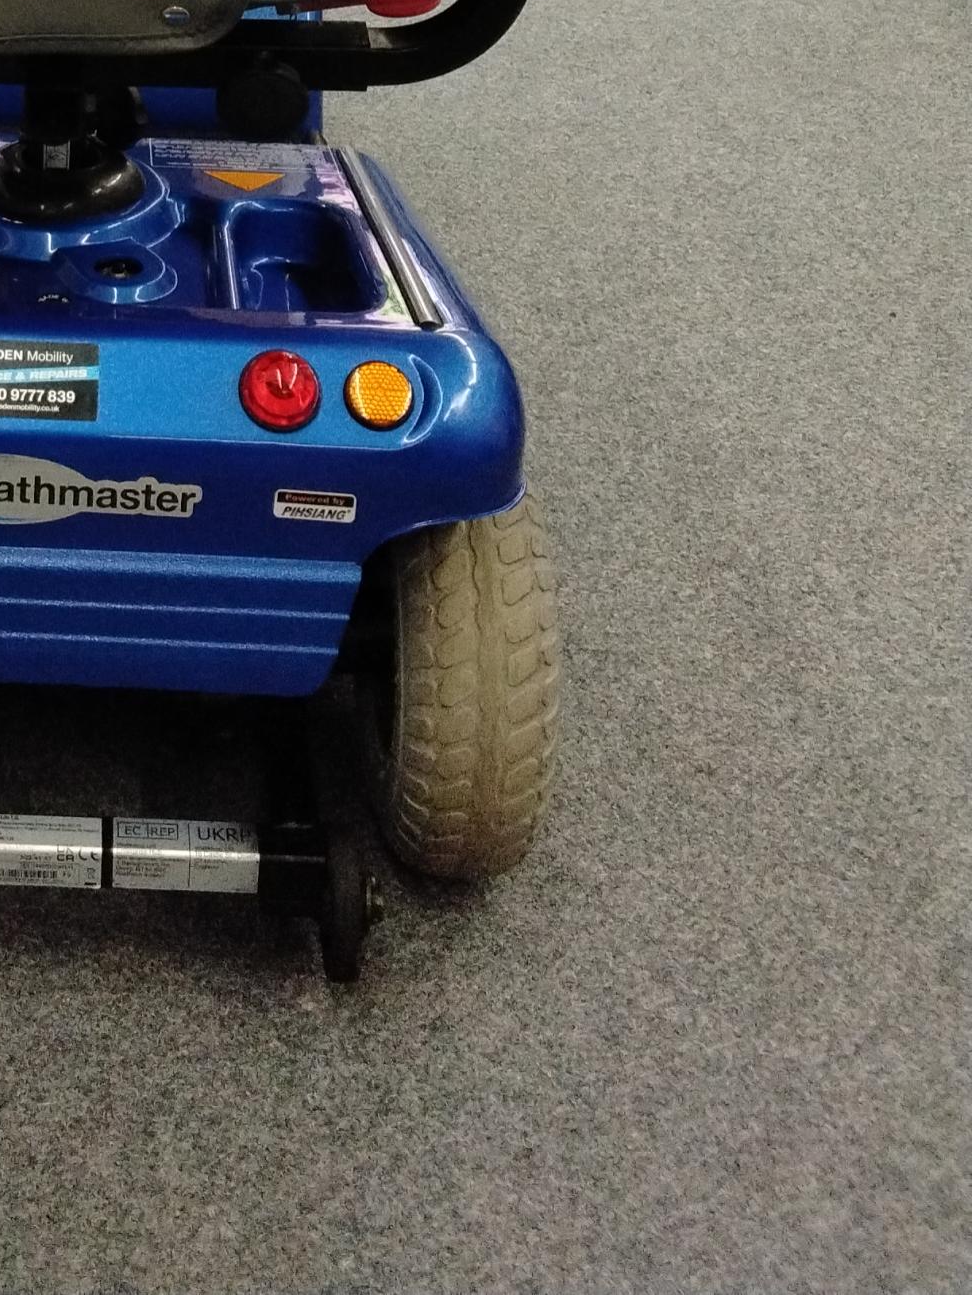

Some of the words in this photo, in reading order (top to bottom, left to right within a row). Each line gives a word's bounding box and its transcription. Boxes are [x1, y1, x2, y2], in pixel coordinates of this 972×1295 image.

[27, 351, 74, 365] Mobility
[30, 368, 89, 380] REPAIRS
[10, 388, 45, 402] 9777
[47, 390, 76, 403] 839
[285, 493, 330, 503] Powered
[282, 506, 347, 520] PIHSIANG
[125, 825, 141, 836] EC
[150, 827, 175, 836] REP
